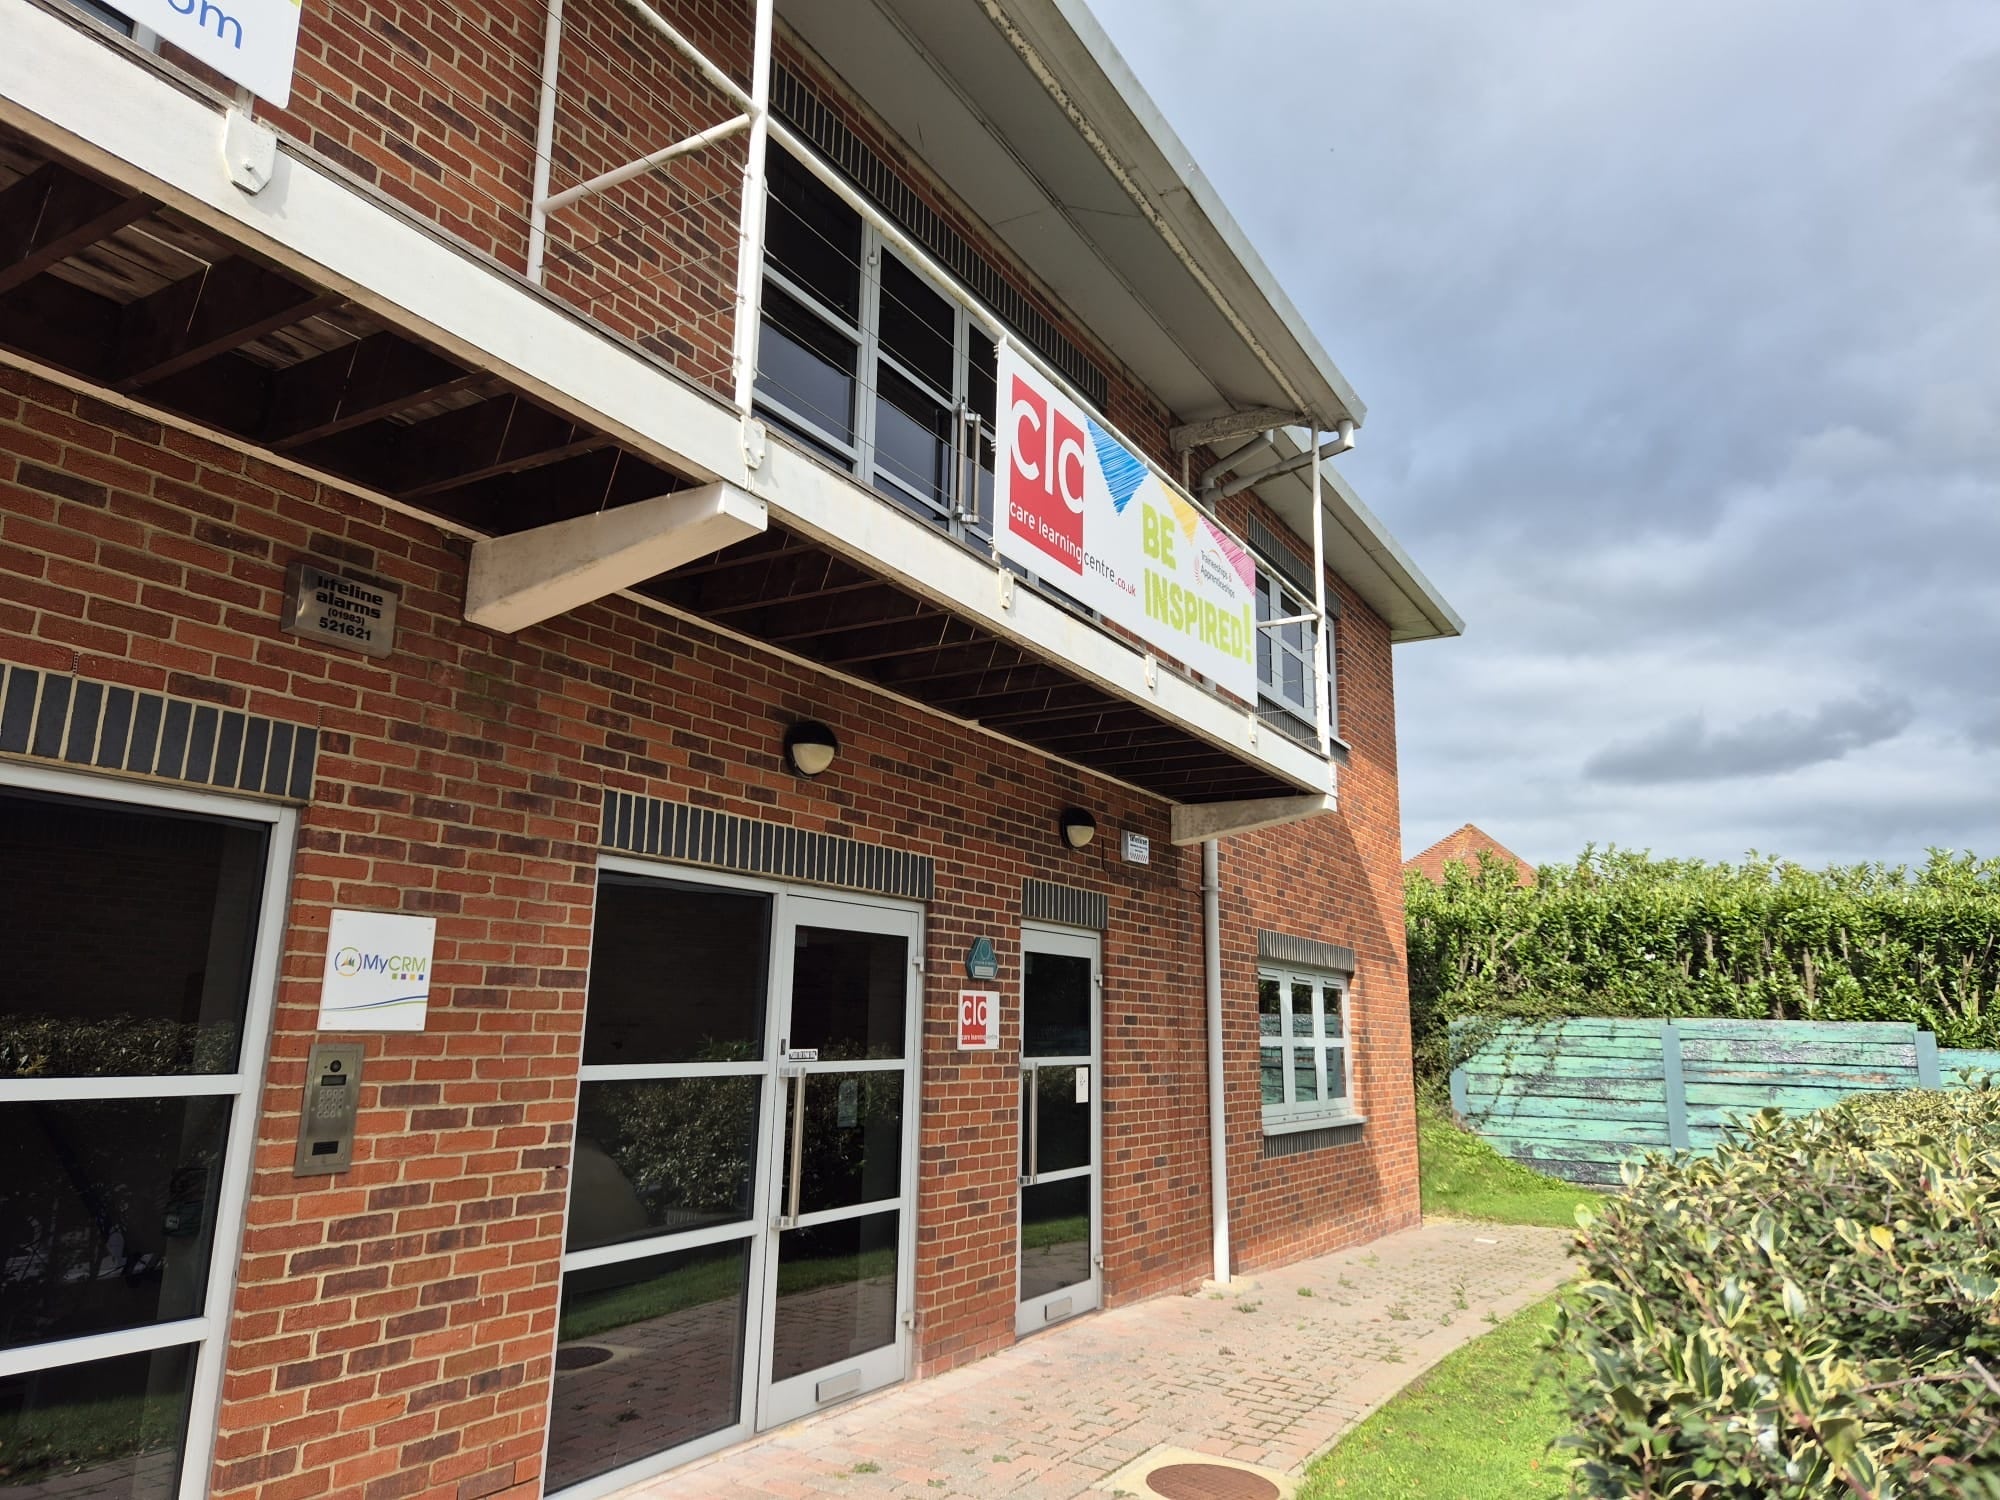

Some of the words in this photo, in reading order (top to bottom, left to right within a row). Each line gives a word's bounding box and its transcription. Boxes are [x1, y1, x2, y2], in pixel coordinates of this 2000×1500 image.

[1009, 502, 1036, 529] care
[1142, 502, 1176, 571] BE
[317, 576, 383, 605] lifeline
[316, 591, 381, 619] alarms
[1144, 558, 1252, 665] INSPIRED!
[319, 616, 371, 641] 521621
[363, 954, 426, 974] MyCRM
